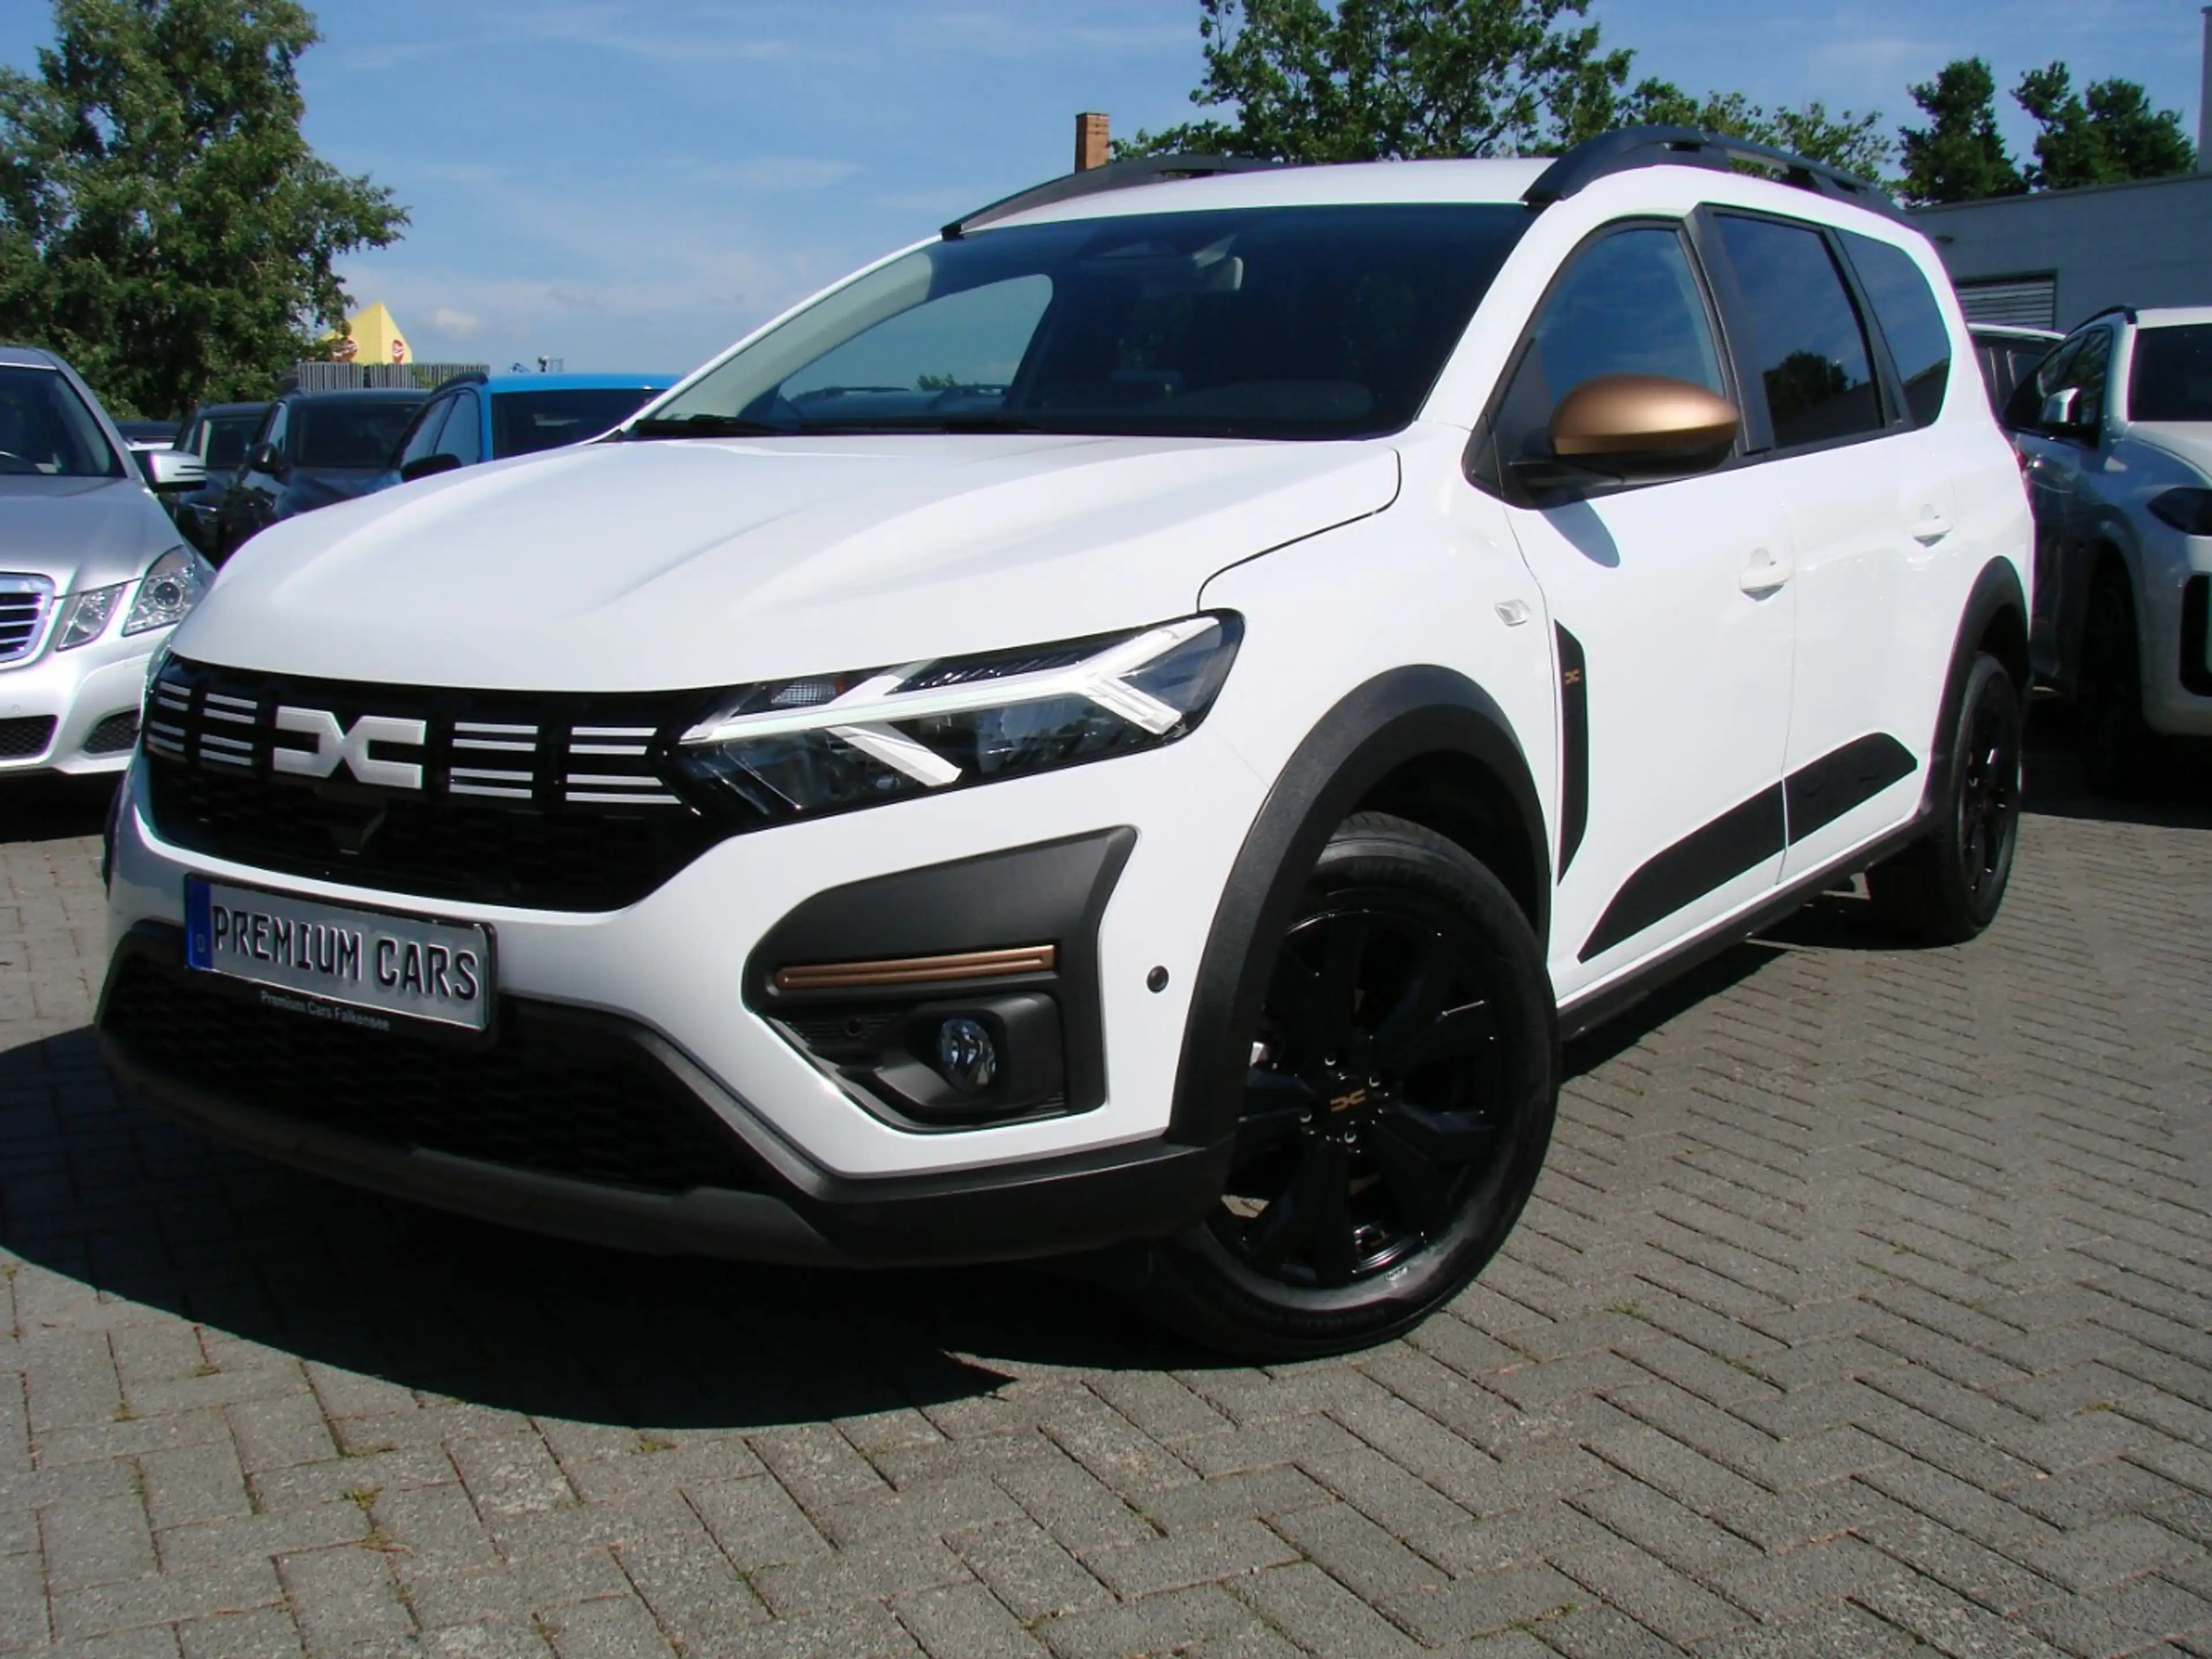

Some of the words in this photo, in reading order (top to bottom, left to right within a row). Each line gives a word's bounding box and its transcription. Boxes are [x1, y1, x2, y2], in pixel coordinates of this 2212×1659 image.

[212, 906, 362, 981] PREMIUM
[376, 937, 479, 1001] CARS
[261, 990, 305, 1013] Premium
[307, 1001, 332, 1018] Cars
